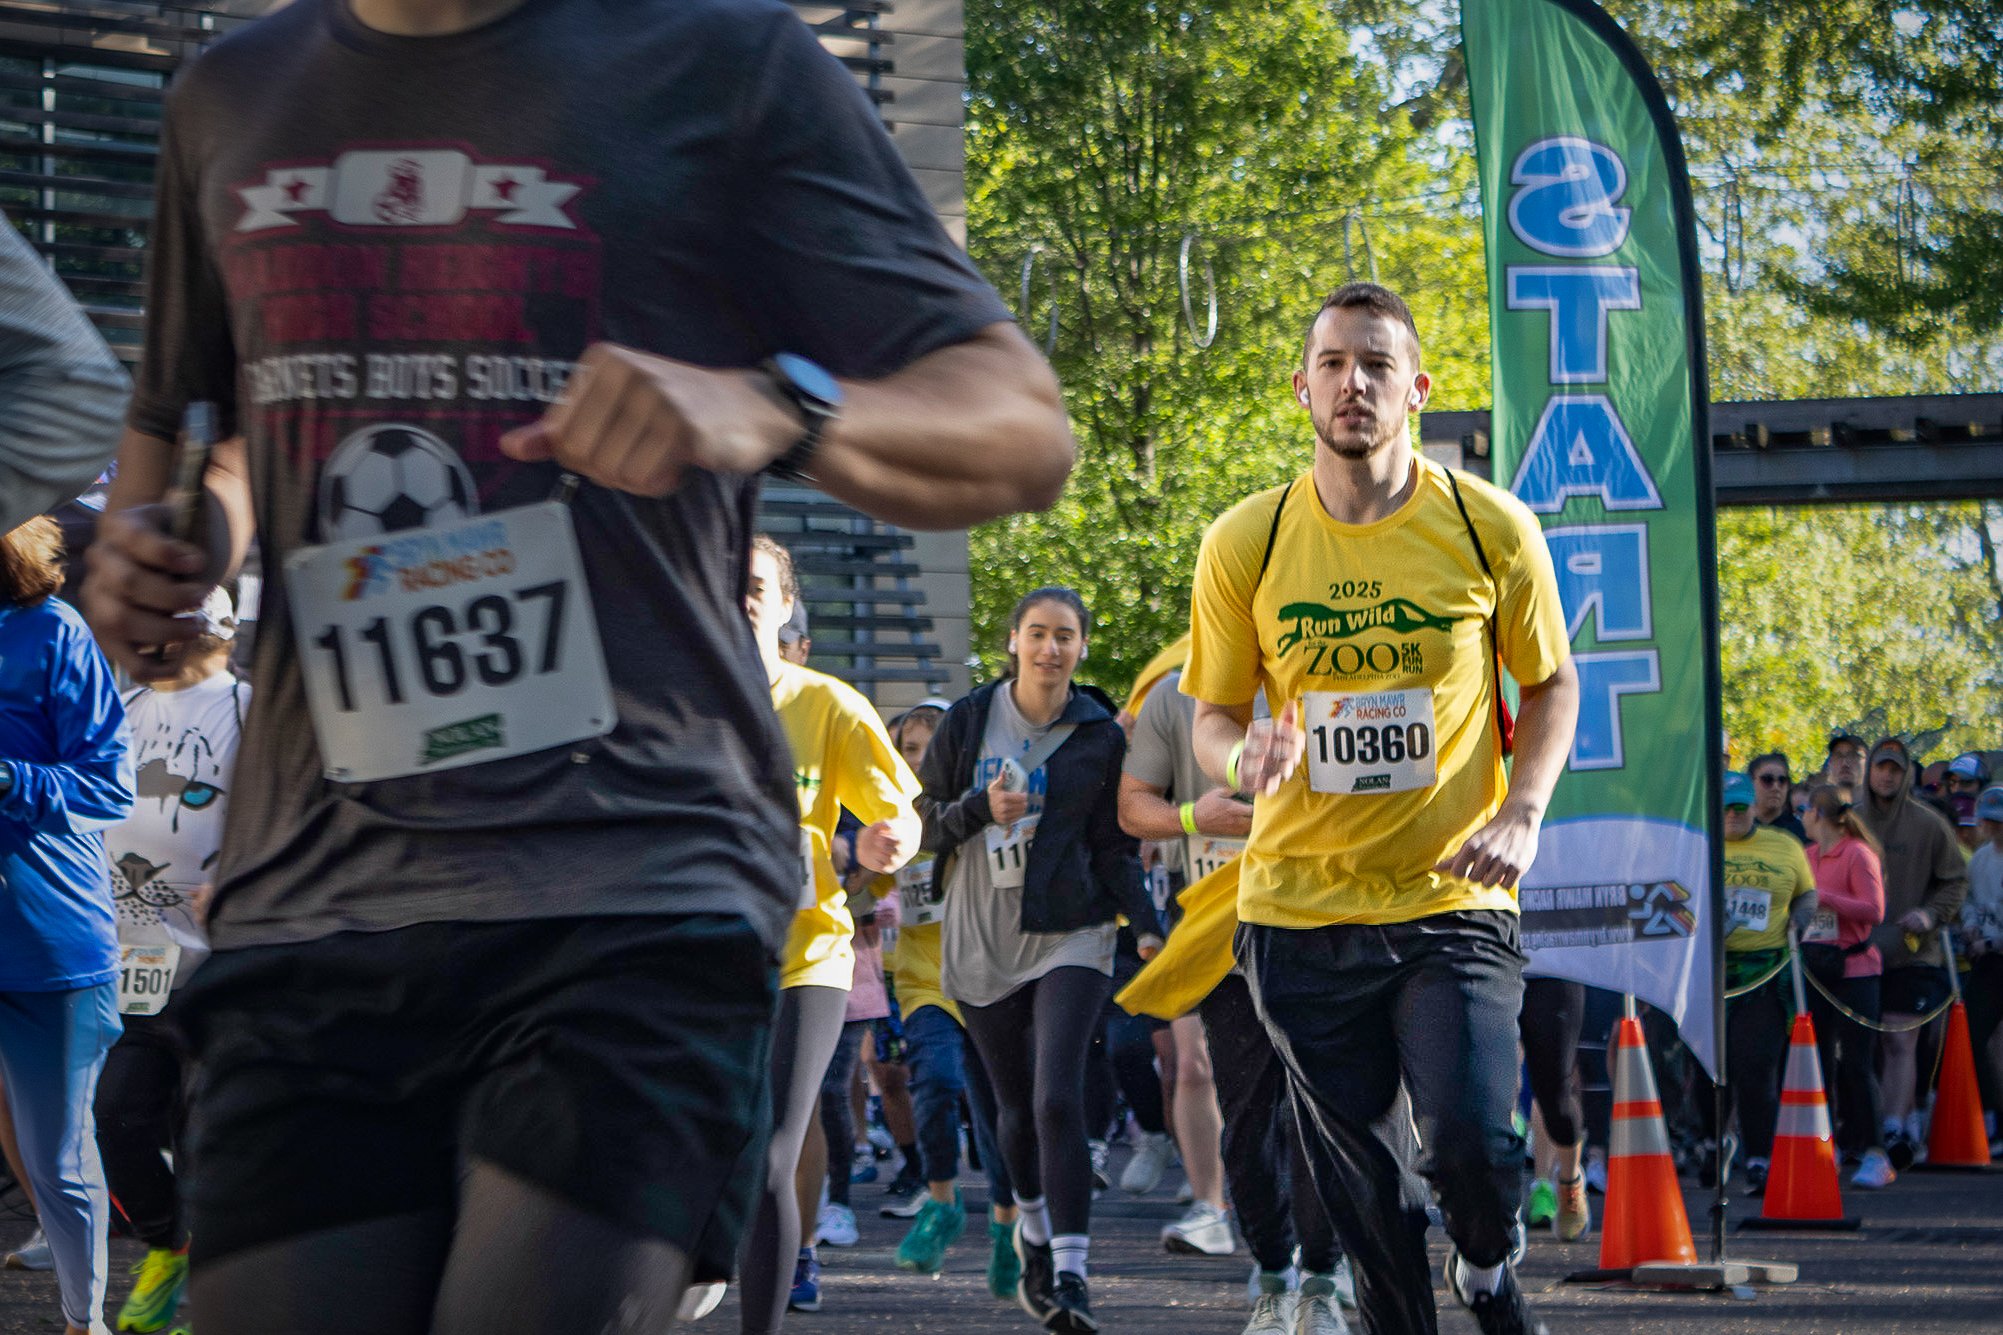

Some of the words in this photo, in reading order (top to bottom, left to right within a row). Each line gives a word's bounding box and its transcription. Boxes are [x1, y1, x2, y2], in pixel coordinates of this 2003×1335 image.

[365, 353, 459, 401] BOYS
[465, 354, 590, 405] SOCCE
[1328, 580, 1382, 600] 2025
[1300, 616, 1341, 640] Run
[1347, 604, 1396, 630] Wild
[317, 580, 568, 712] 11637
[1401, 643, 1421, 656] 5K
[1303, 642, 1400, 676] ZOO
[1402, 655, 1423, 666] FUN
[1402, 664, 1423, 674] RUN
[1355, 695, 1377, 708] BRYN
[1379, 694, 1406, 706] MAWR
[1356, 708, 1391, 720] RACING
[1392, 708, 1407, 718] CO
[1312, 722, 1430, 765] 10360
[1358, 776, 1389, 785] NOLAN
[993, 843, 1029, 871] 11
[120, 968, 172, 994] 1501
